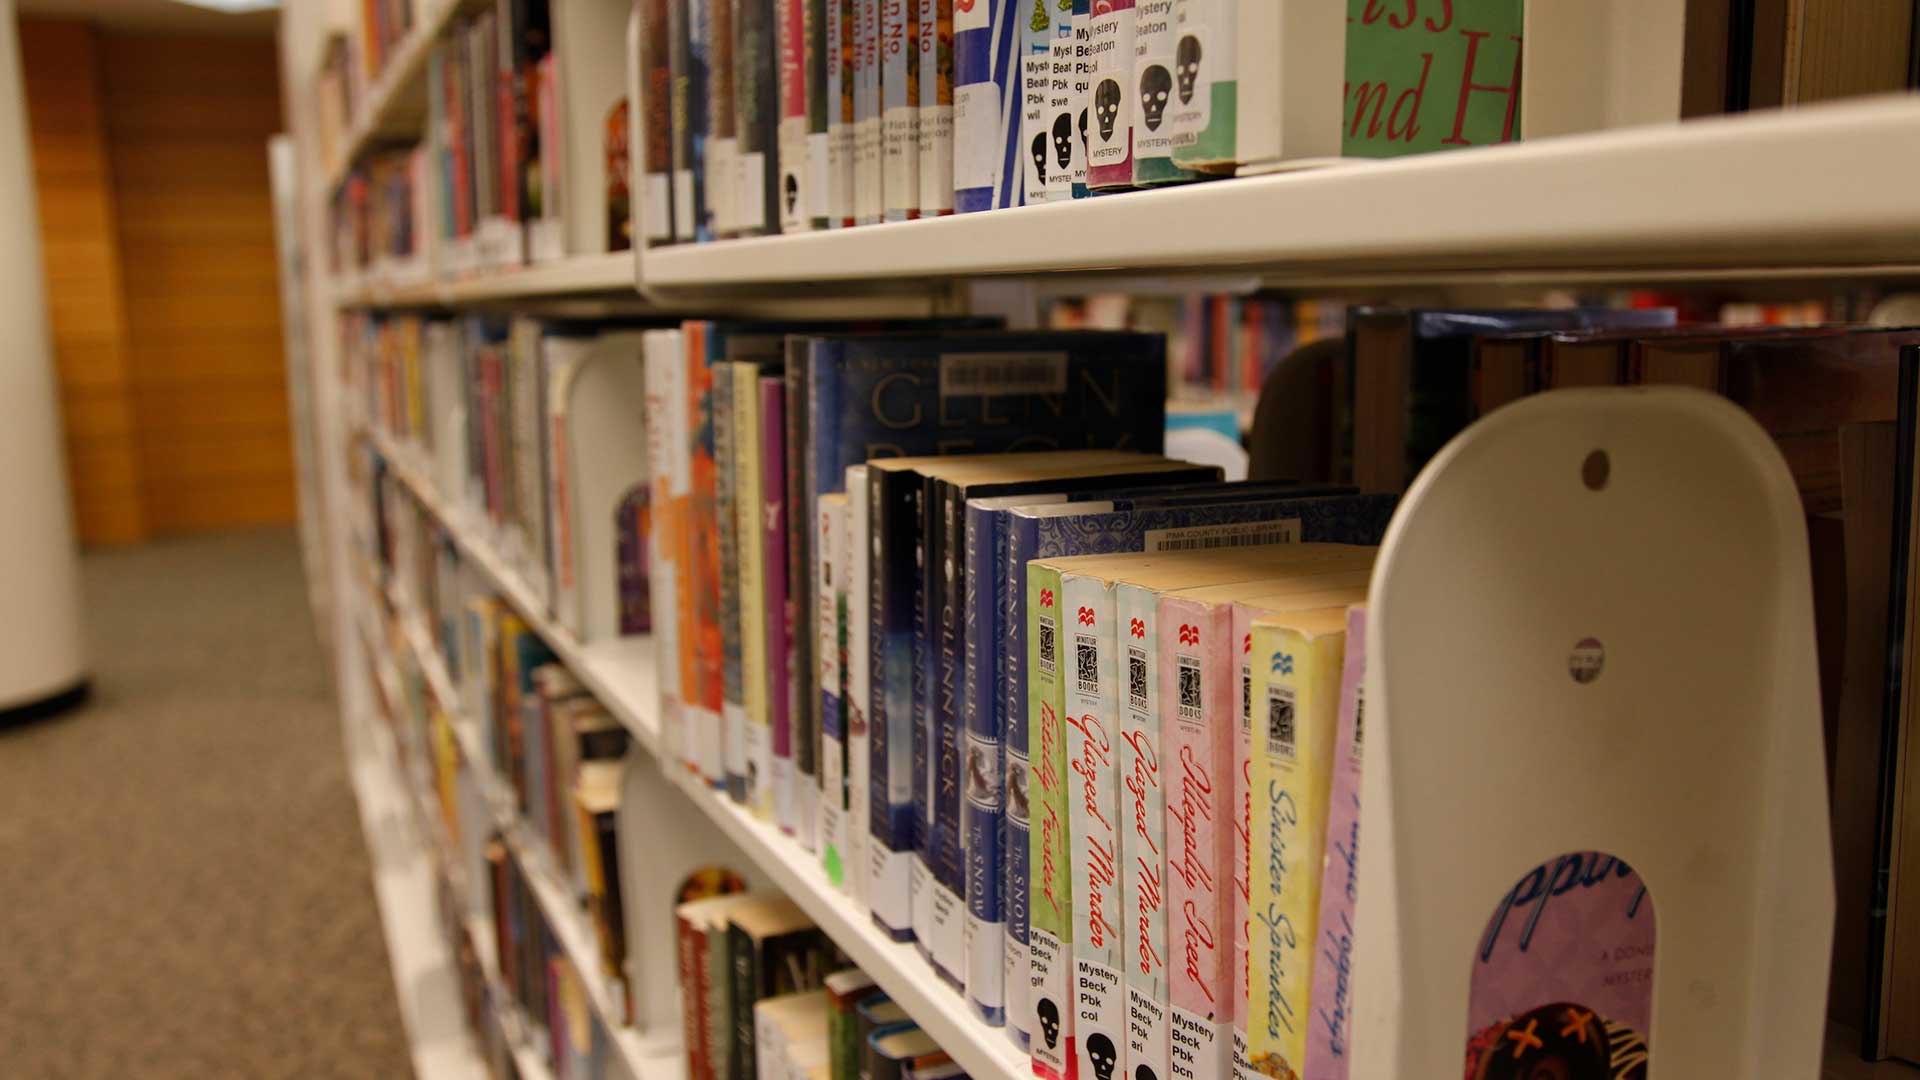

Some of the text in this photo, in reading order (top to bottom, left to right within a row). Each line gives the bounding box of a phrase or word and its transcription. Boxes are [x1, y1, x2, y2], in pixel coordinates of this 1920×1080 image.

[889, 23, 903, 54] No
[920, 21, 933, 53] No
[1052, 79, 1068, 91] Pbk
[1027, 94, 1045, 104] Pbk
[1051, 96, 1069, 107] swe
[1027, 109, 1041, 120] wil
[1093, 147, 1123, 158] MYSTERY
[966, 526, 977, 720] GLENN BECK
[1007, 533, 1019, 736] GLENN BECK
[941, 603, 956, 715] GLENN
[1077, 680, 1099, 694] BOOKS
[1130, 695, 1148, 710] BOOKS
[1179, 705, 1202, 721] BOOKS
[942, 721, 956, 794] BECK
[1268, 779, 1297, 896] Sinister
[974, 853, 985, 917] SNOW
[1086, 834, 1118, 949] Murder
[1013, 874, 1025, 941] SNOW
[1137, 857, 1163, 976] Murder
[1183, 900, 1215, 1004] Iced
[1031, 960, 1048, 975] Pbk
[1079, 962, 1119, 985] Mystery
[1256, 902, 1297, 1040] Sprinkles
[1080, 977, 1107, 993] Beck
[1080, 993, 1102, 1008] Pbk
[1130, 990, 1163, 1021] Mystery
[1081, 1009, 1098, 1021] col
[1130, 1006, 1153, 1028] Beck
[1131, 1022, 1148, 1040] Pbk
[1171, 1012, 1215, 1042] Mystery
[1131, 1040, 1143, 1054] ari
[1172, 1028, 1201, 1050] Beck
[1172, 1045, 1194, 1064] Pbk
[1172, 1061, 1194, 1079] bcn
